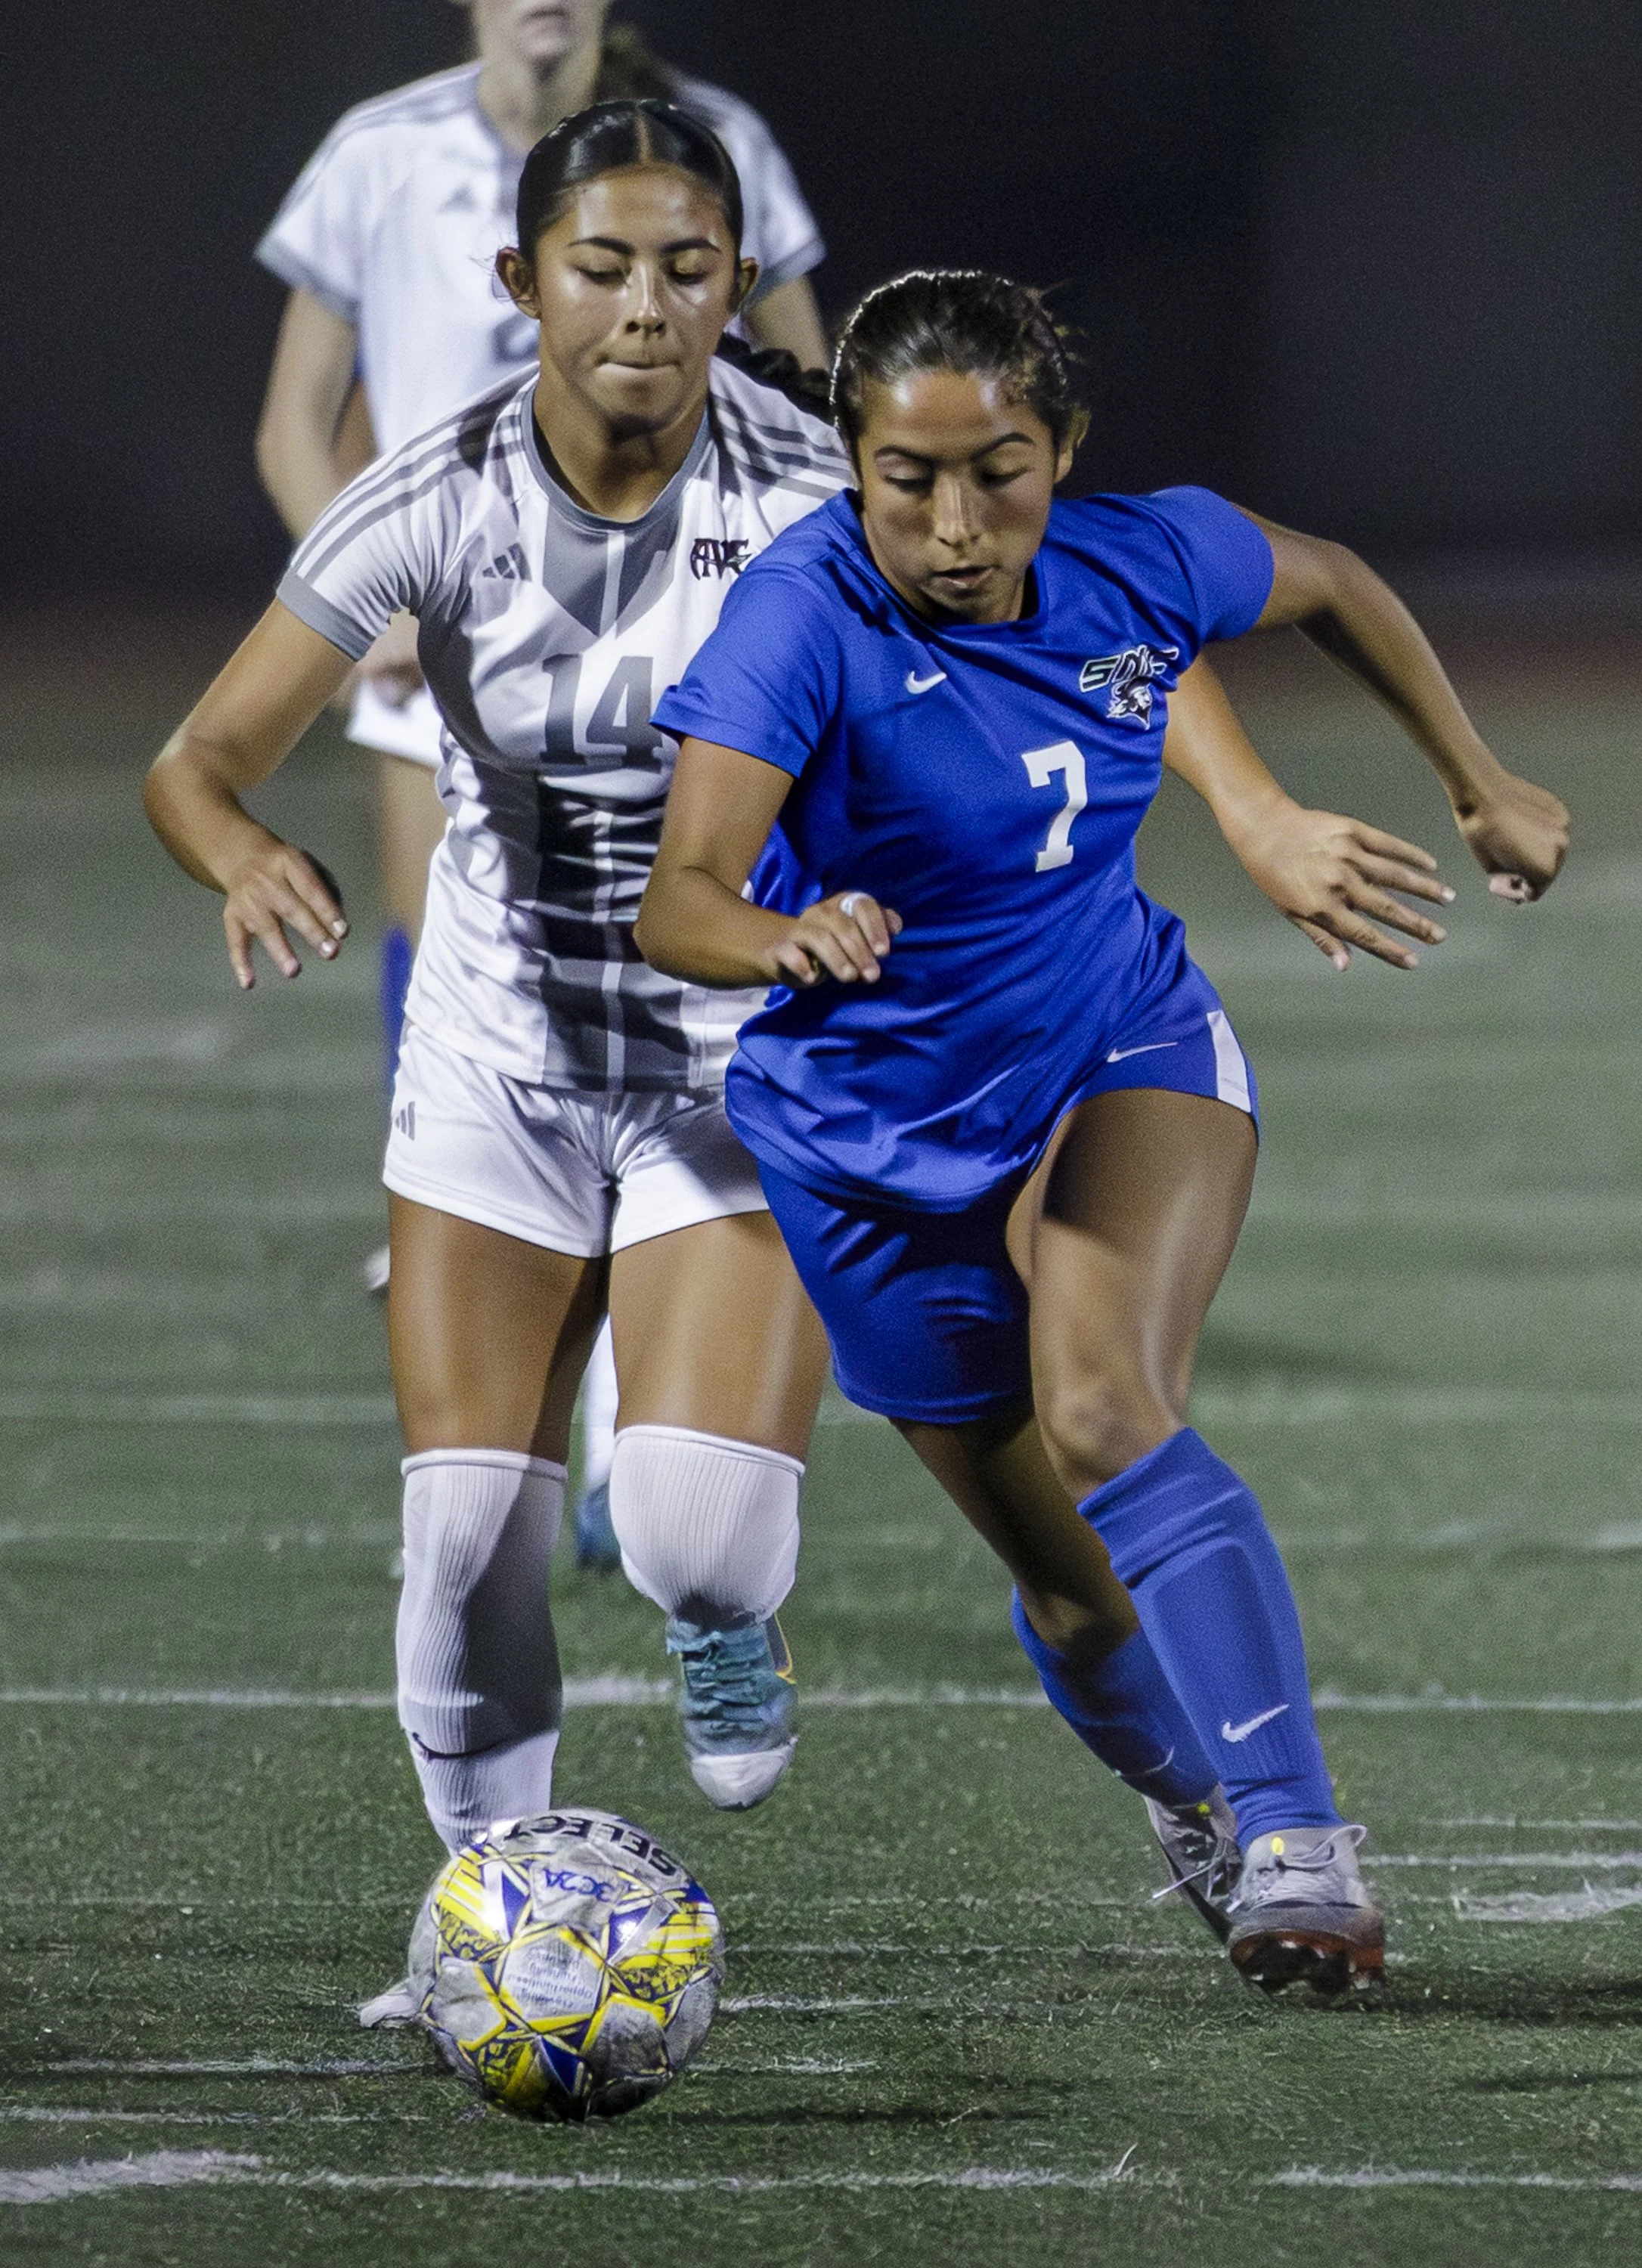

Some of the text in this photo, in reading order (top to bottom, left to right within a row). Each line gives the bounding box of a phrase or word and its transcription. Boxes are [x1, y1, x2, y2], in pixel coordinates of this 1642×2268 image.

[539, 652, 664, 774] 14
[1021, 739, 1089, 872] 7
[503, 1815, 678, 1876] SELECT
[543, 1868, 615, 1903] 3C2A
